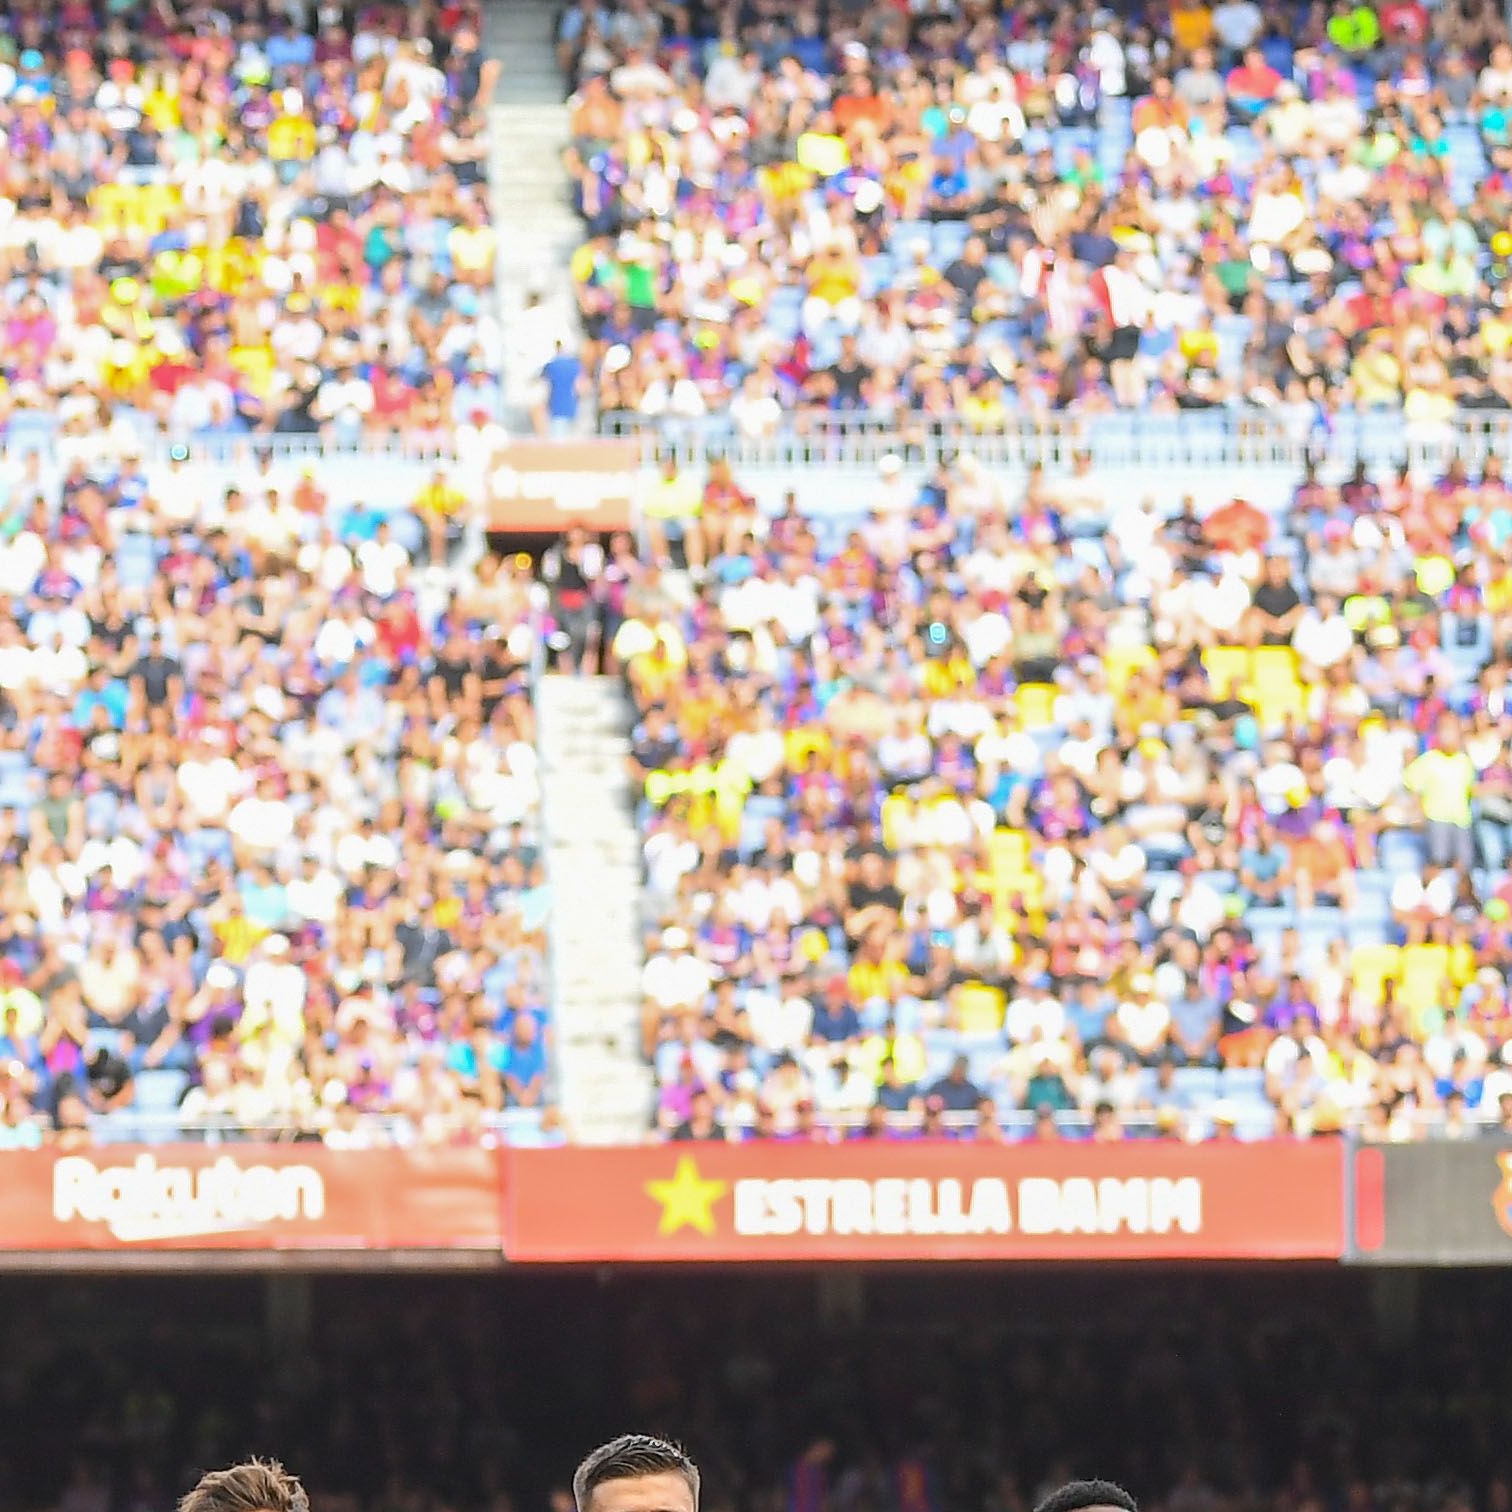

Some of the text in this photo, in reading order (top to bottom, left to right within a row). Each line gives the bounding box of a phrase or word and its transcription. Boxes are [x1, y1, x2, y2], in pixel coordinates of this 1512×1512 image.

[53, 1153, 324, 1235] Rakuten
[734, 1177, 1202, 1235] ESTRELLA DAMM
